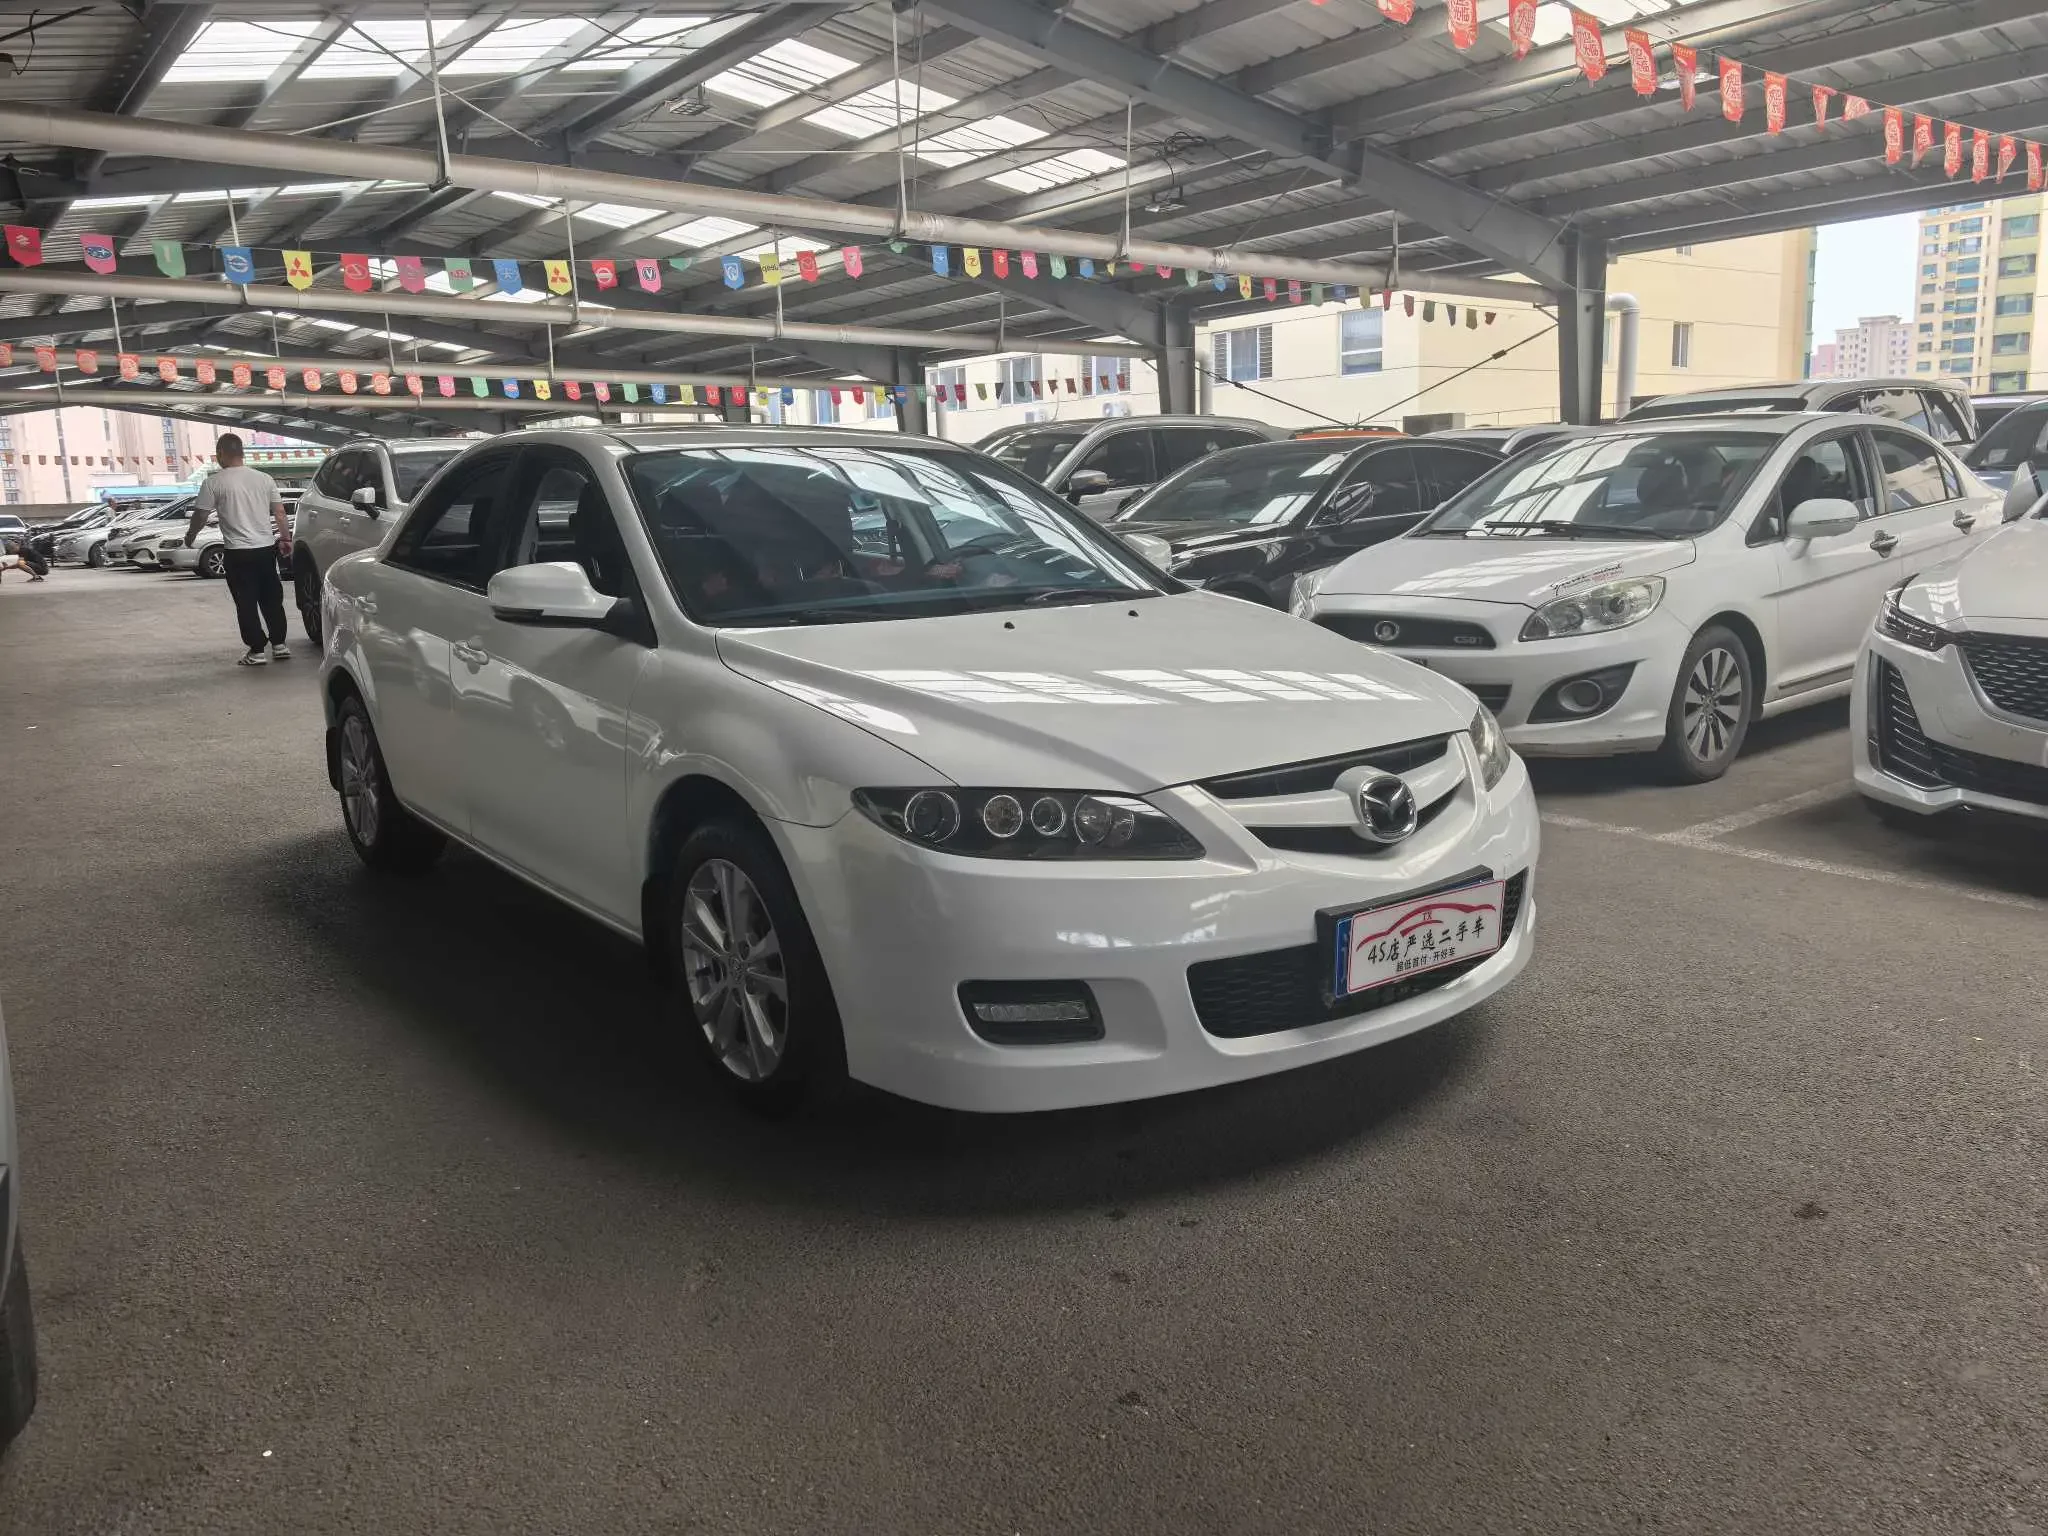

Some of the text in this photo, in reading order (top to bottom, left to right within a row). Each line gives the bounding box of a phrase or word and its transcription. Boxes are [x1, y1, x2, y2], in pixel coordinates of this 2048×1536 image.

[1422, 911, 1432, 920] TX
[1367, 916, 1484, 965] 4S店严选二手车
